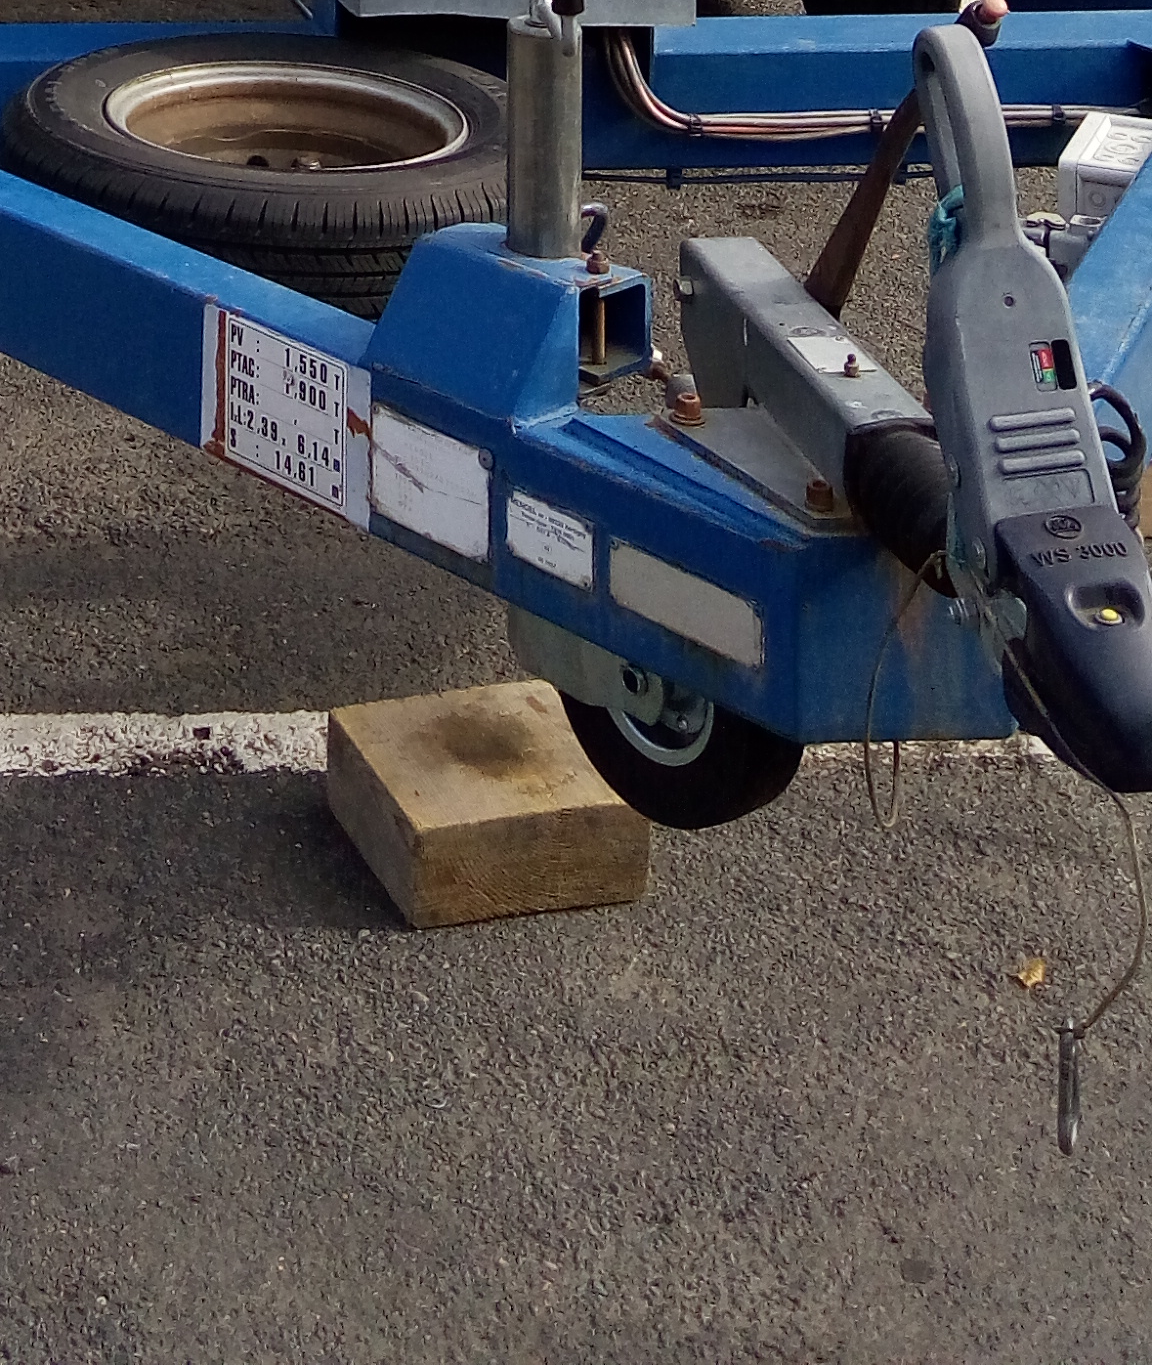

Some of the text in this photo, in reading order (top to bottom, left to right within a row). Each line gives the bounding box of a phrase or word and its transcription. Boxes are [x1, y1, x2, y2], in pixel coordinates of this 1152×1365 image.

[230, 323, 244, 346] PV
[285, 347, 327, 384] 1,550
[334, 373, 340, 390] T
[334, 401, 339, 418] T
[297, 434, 329, 467] 6,14
[334, 428, 339, 445] T
[230, 427, 237, 448] S
[275, 450, 315, 486] 14,61
[1030, 541, 1129, 568] WS 3000
